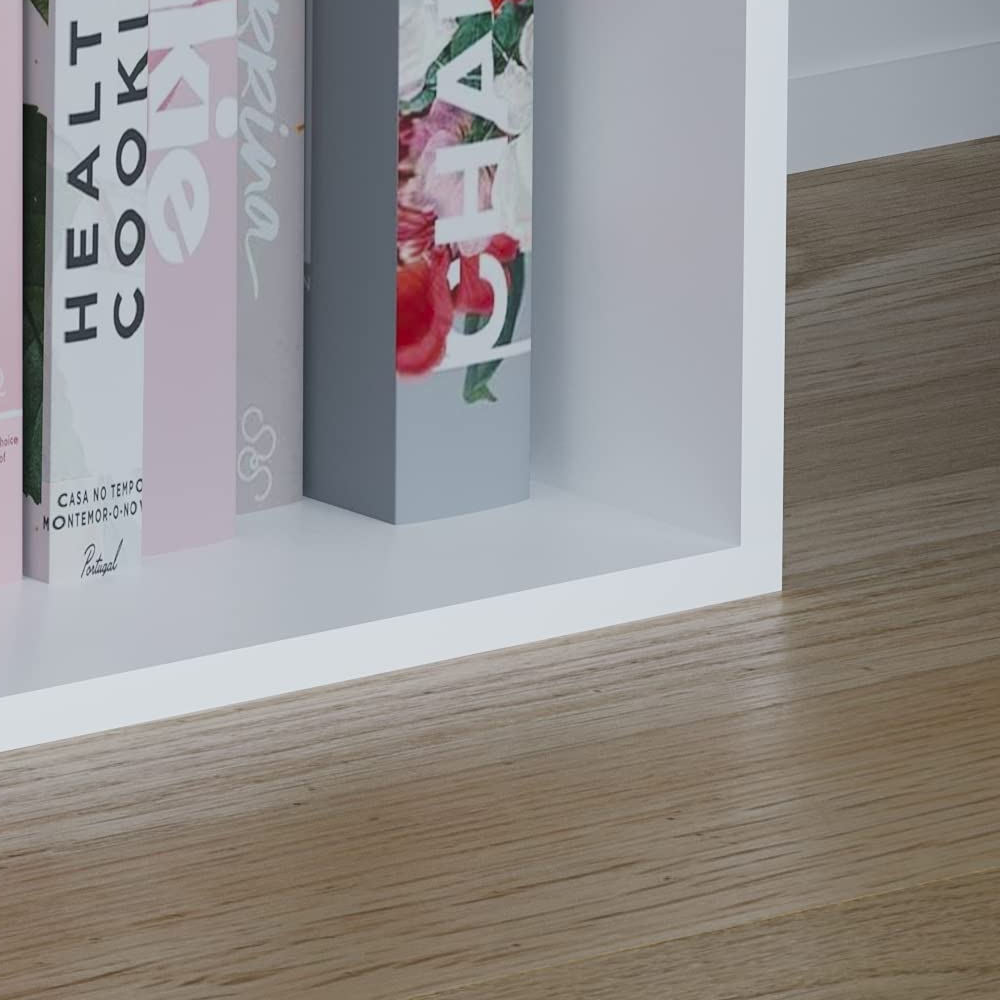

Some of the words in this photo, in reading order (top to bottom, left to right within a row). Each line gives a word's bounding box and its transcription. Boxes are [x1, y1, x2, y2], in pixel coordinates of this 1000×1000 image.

[0, 452, 6, 464] of
[57, 489, 88, 507] CASA
[93, 486, 106, 501] NO
[81, 537, 124, 578] Portugal
